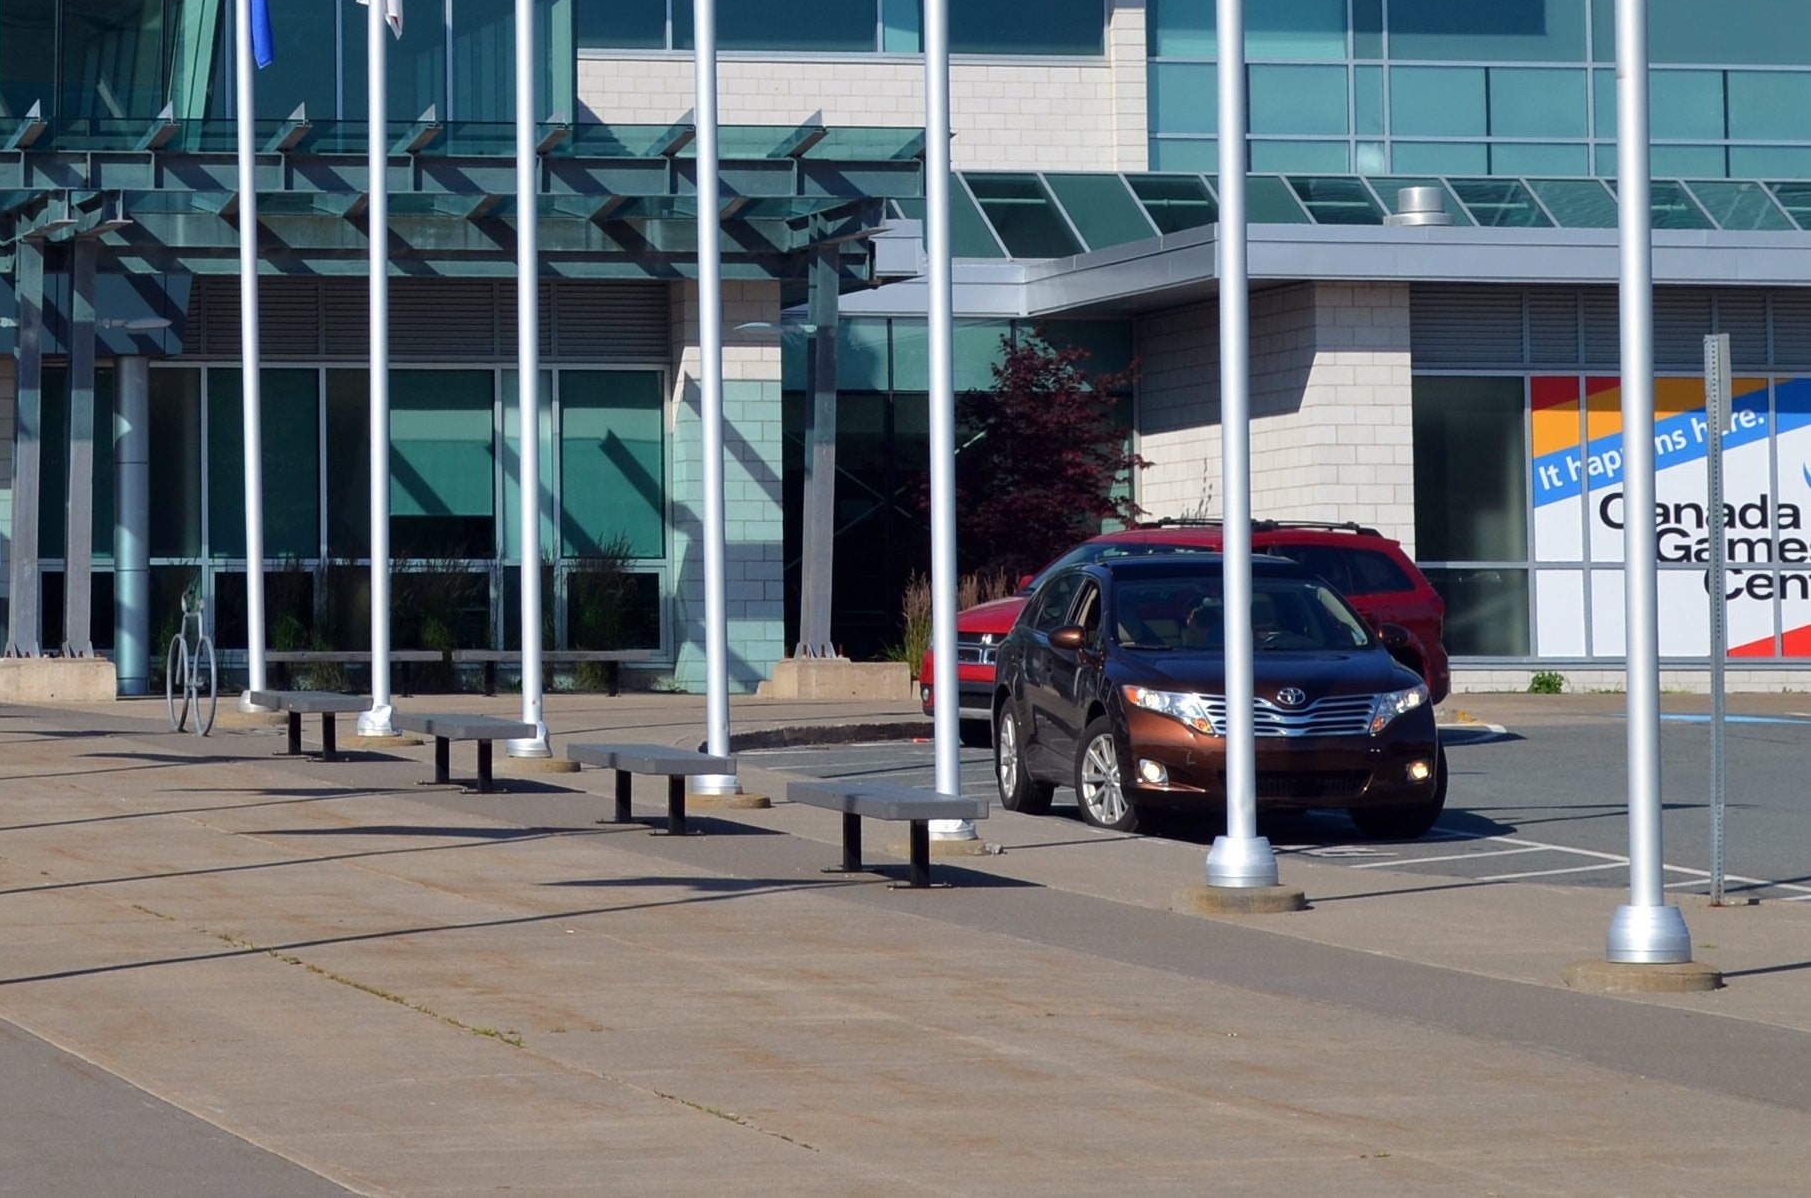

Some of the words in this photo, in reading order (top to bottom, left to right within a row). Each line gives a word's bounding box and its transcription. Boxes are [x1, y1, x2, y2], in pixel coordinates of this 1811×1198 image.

[1538, 464, 1564, 490] It
[1565, 429, 1687, 478] hapns
[1690, 408, 1765, 444] hre.
[1656, 527, 1811, 565] Game
[1704, 566, 1811, 601] Cen
